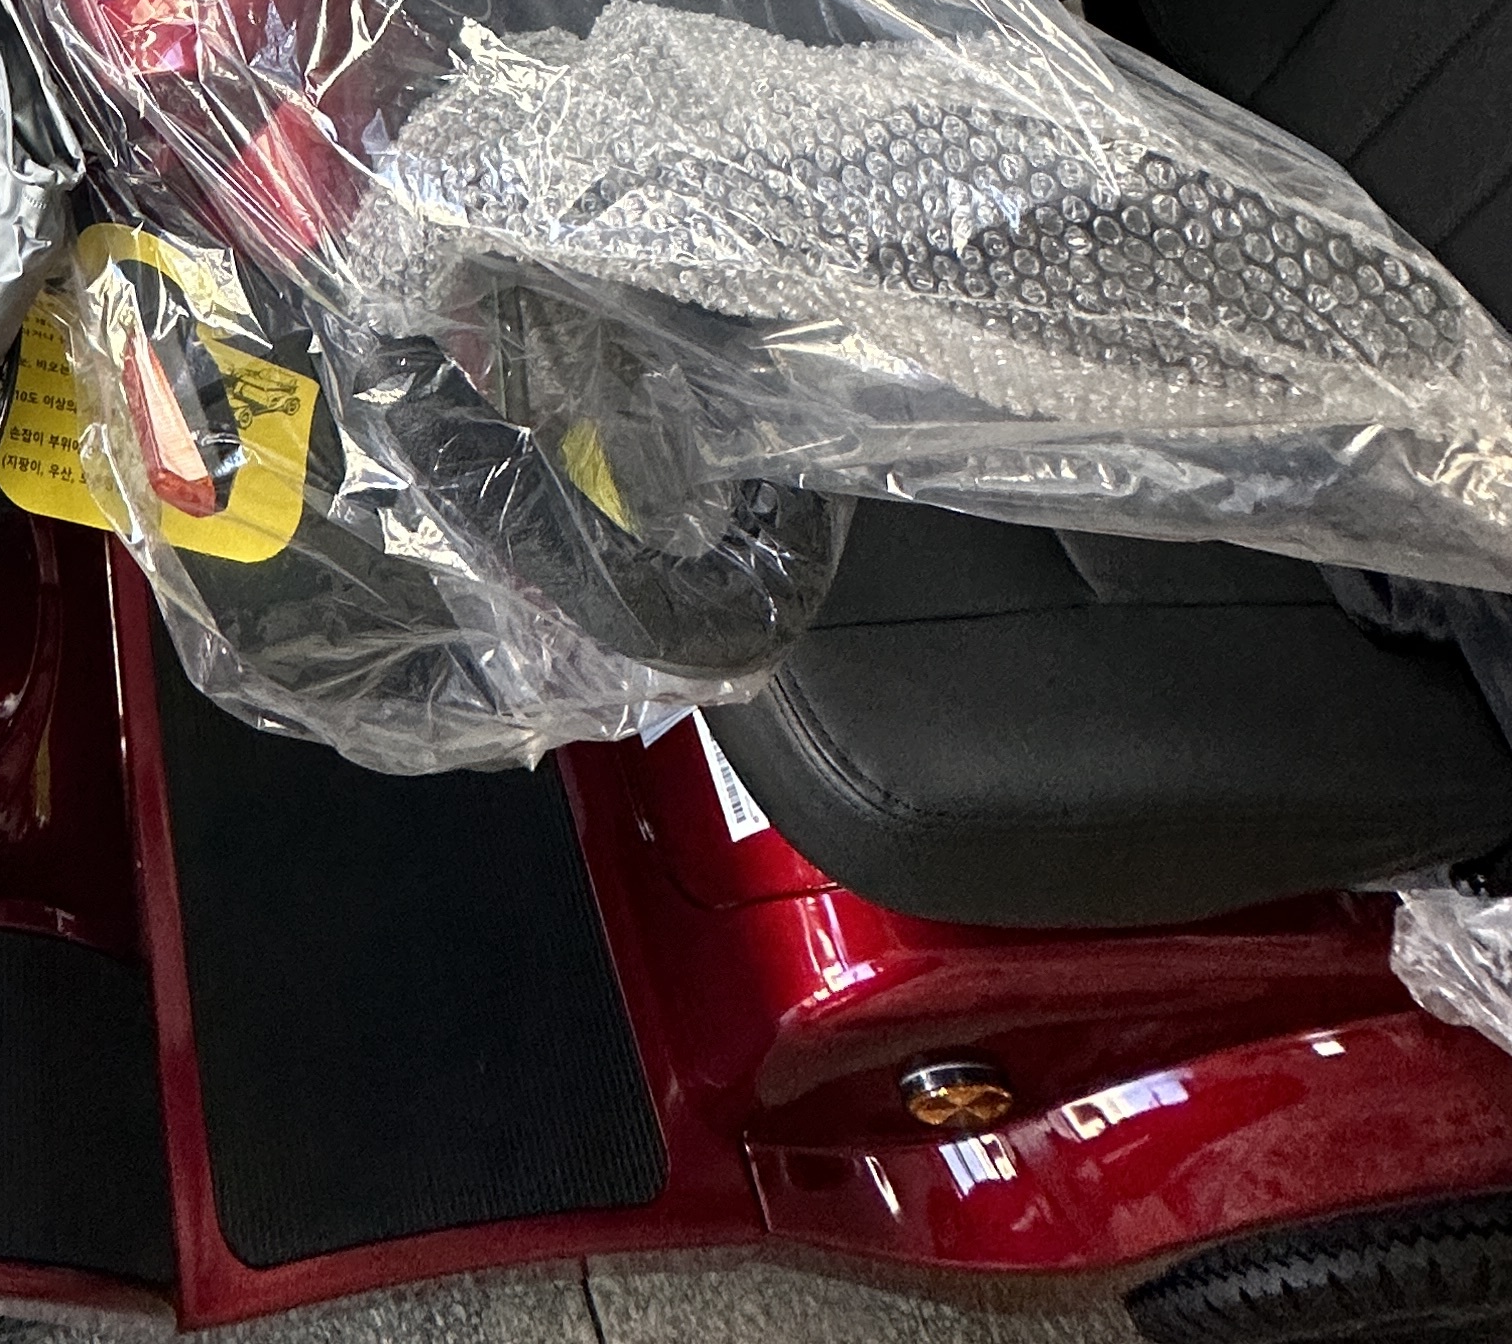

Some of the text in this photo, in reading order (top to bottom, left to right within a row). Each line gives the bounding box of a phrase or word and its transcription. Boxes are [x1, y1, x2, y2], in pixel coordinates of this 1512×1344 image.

[43, 395, 77, 414] 이상의
[9, 426, 44, 446] 손잡이
[1, 453, 44, 476] (지팡이,
[48, 463, 75, 484] 우산,
